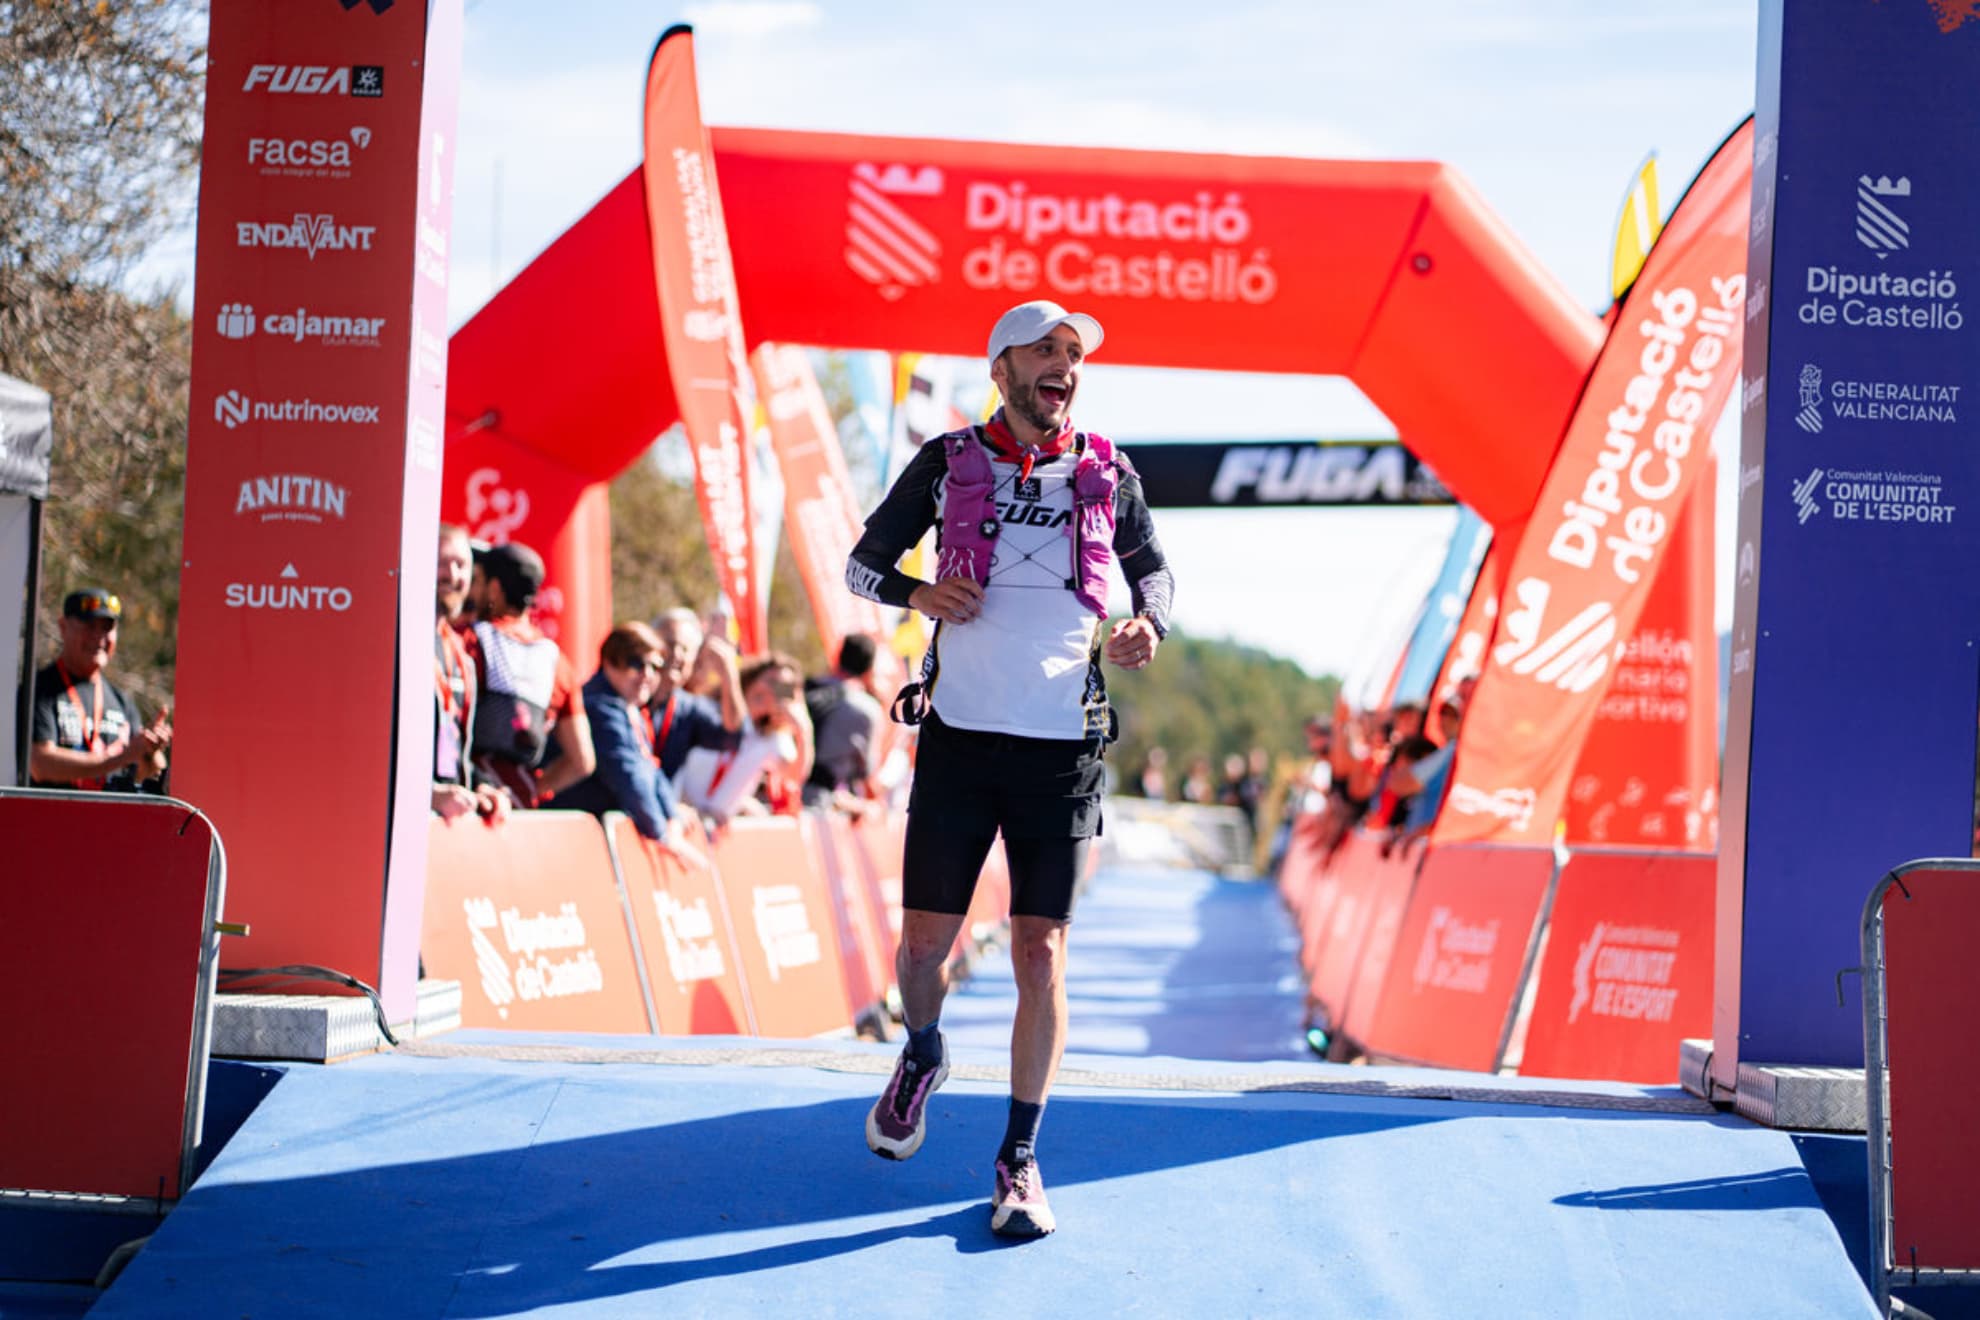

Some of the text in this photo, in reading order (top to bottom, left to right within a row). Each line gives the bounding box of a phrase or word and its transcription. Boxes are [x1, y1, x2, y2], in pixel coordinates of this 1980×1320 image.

[242, 65, 350, 94] FUGA
[966, 182, 1250, 243] Diputació
[237, 213, 376, 261] ENDAVANT
[962, 236, 1277, 303] de Castelló
[1807, 266, 1956, 300] Diputació
[264, 308, 385, 343] cajamar
[1799, 299, 1837, 324] de
[1843, 300, 1963, 331] Castelló
[1831, 381, 1960, 403] GENERALITAT
[254, 399, 379, 423] nutrinovex
[1548, 287, 1696, 568] Diputació
[1832, 402, 1955, 423] VALENCIANA
[1606, 274, 1747, 584] de Castelló
[1209, 446, 1406, 502] FUGA
[1827, 469, 1941, 484] Comunitat Valenciana
[235, 475, 346, 519] ANITIN
[1826, 482, 1941, 504] COMUNITAT
[1834, 502, 1955, 523] DE L'ESPORT
[225, 583, 352, 611] SUUNTO
